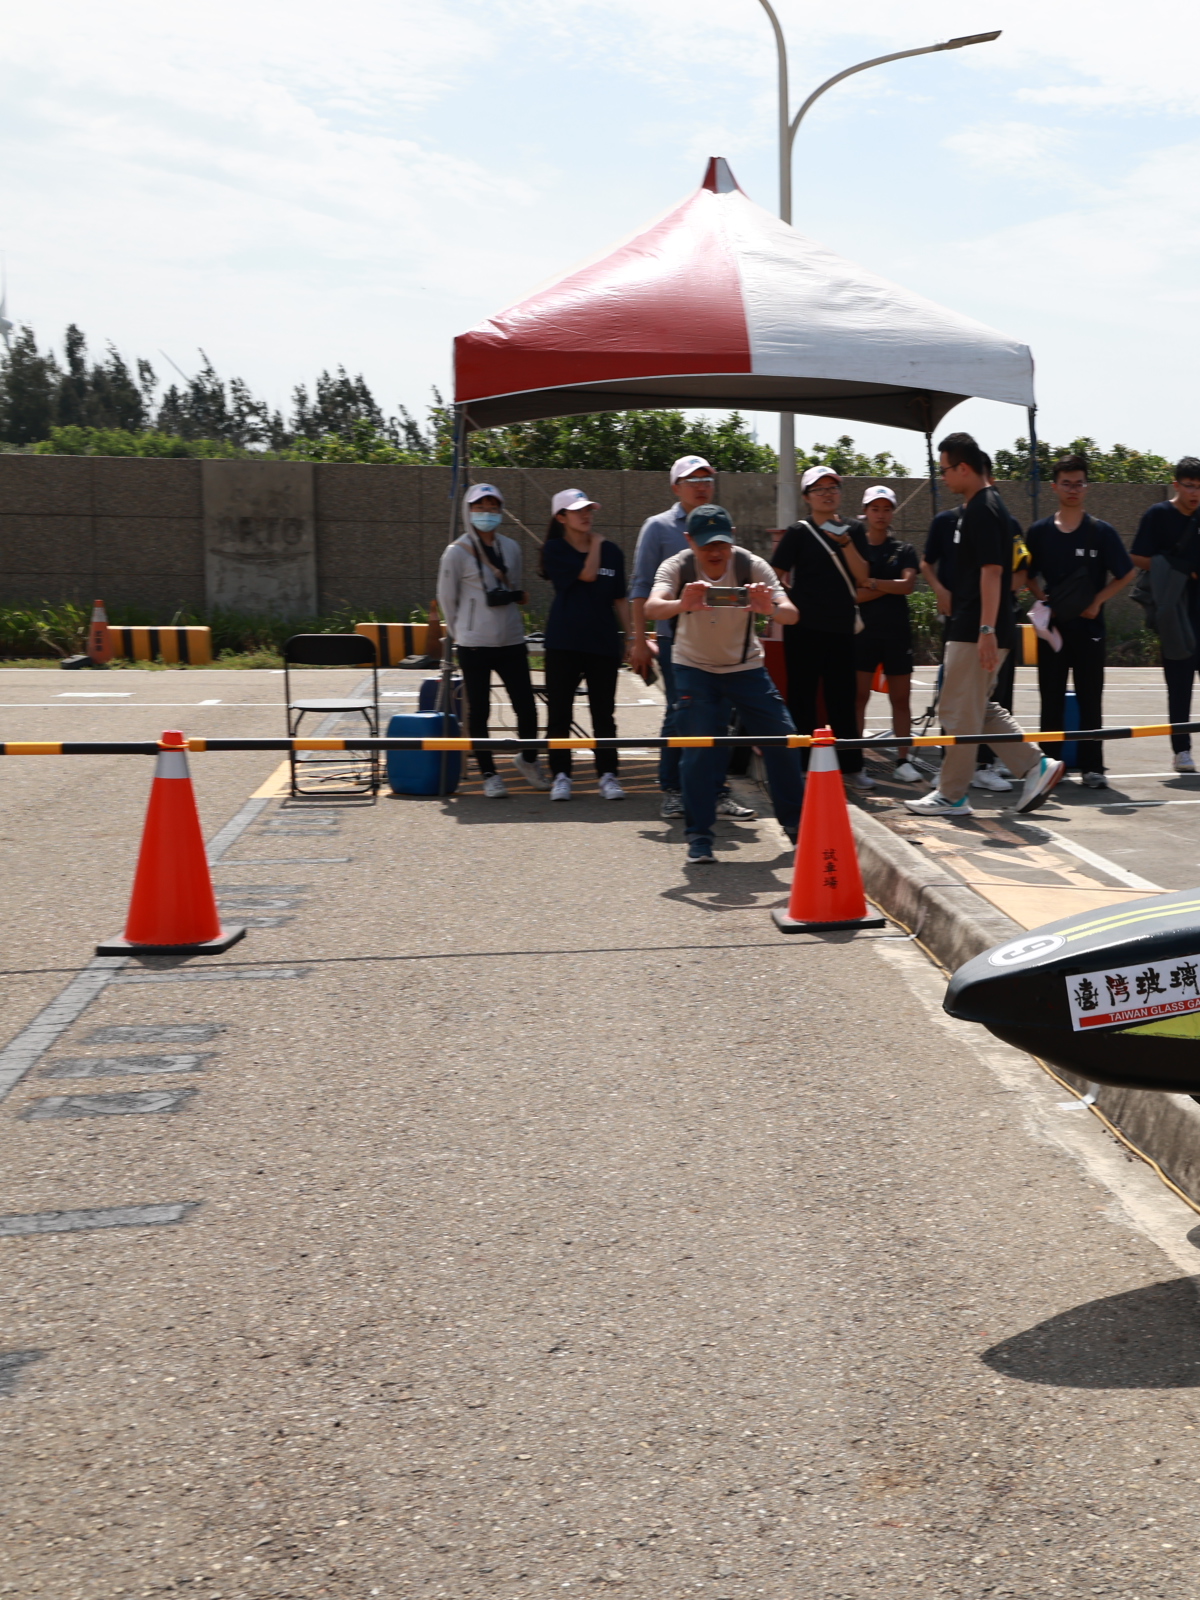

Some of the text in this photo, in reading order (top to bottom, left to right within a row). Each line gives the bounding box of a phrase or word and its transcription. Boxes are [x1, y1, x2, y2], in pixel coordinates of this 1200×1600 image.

[1001, 939, 1055, 961] 9
[1109, 1007, 1148, 1022] TAIWAN
[1151, 1002, 1185, 1015] GLASS
